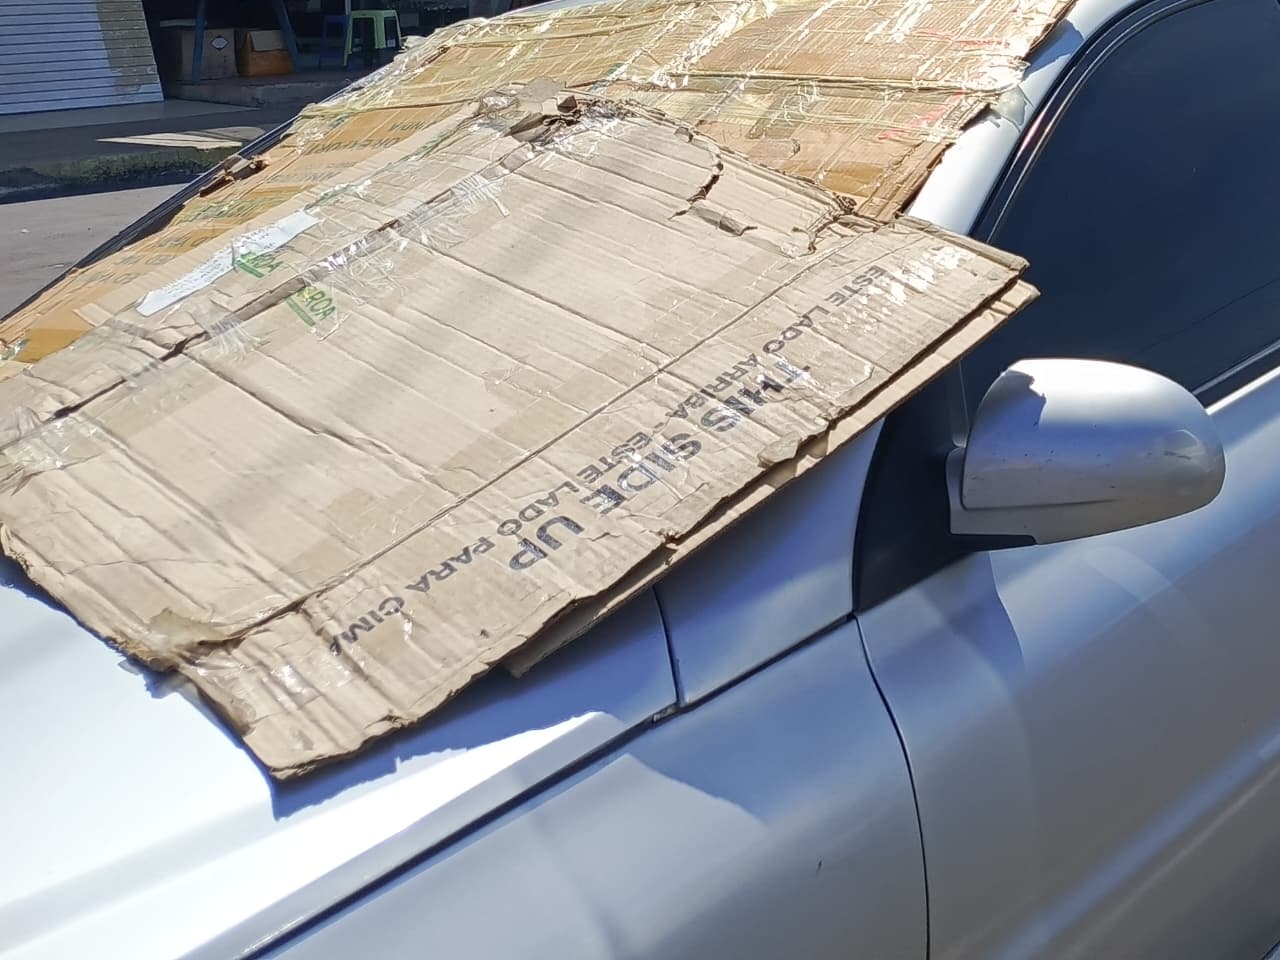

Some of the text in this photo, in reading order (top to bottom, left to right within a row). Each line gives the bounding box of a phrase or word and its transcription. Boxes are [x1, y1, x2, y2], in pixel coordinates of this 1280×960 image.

[824, 265, 887, 307] ESTE
[763, 305, 829, 354] LADO
[665, 353, 758, 420] ARRIBA
[510, 360, 811, 570] THIS SIDE UP
[577, 431, 652, 484] ESTE
[497, 481, 579, 536] LADO
[405, 536, 495, 592] PARA
